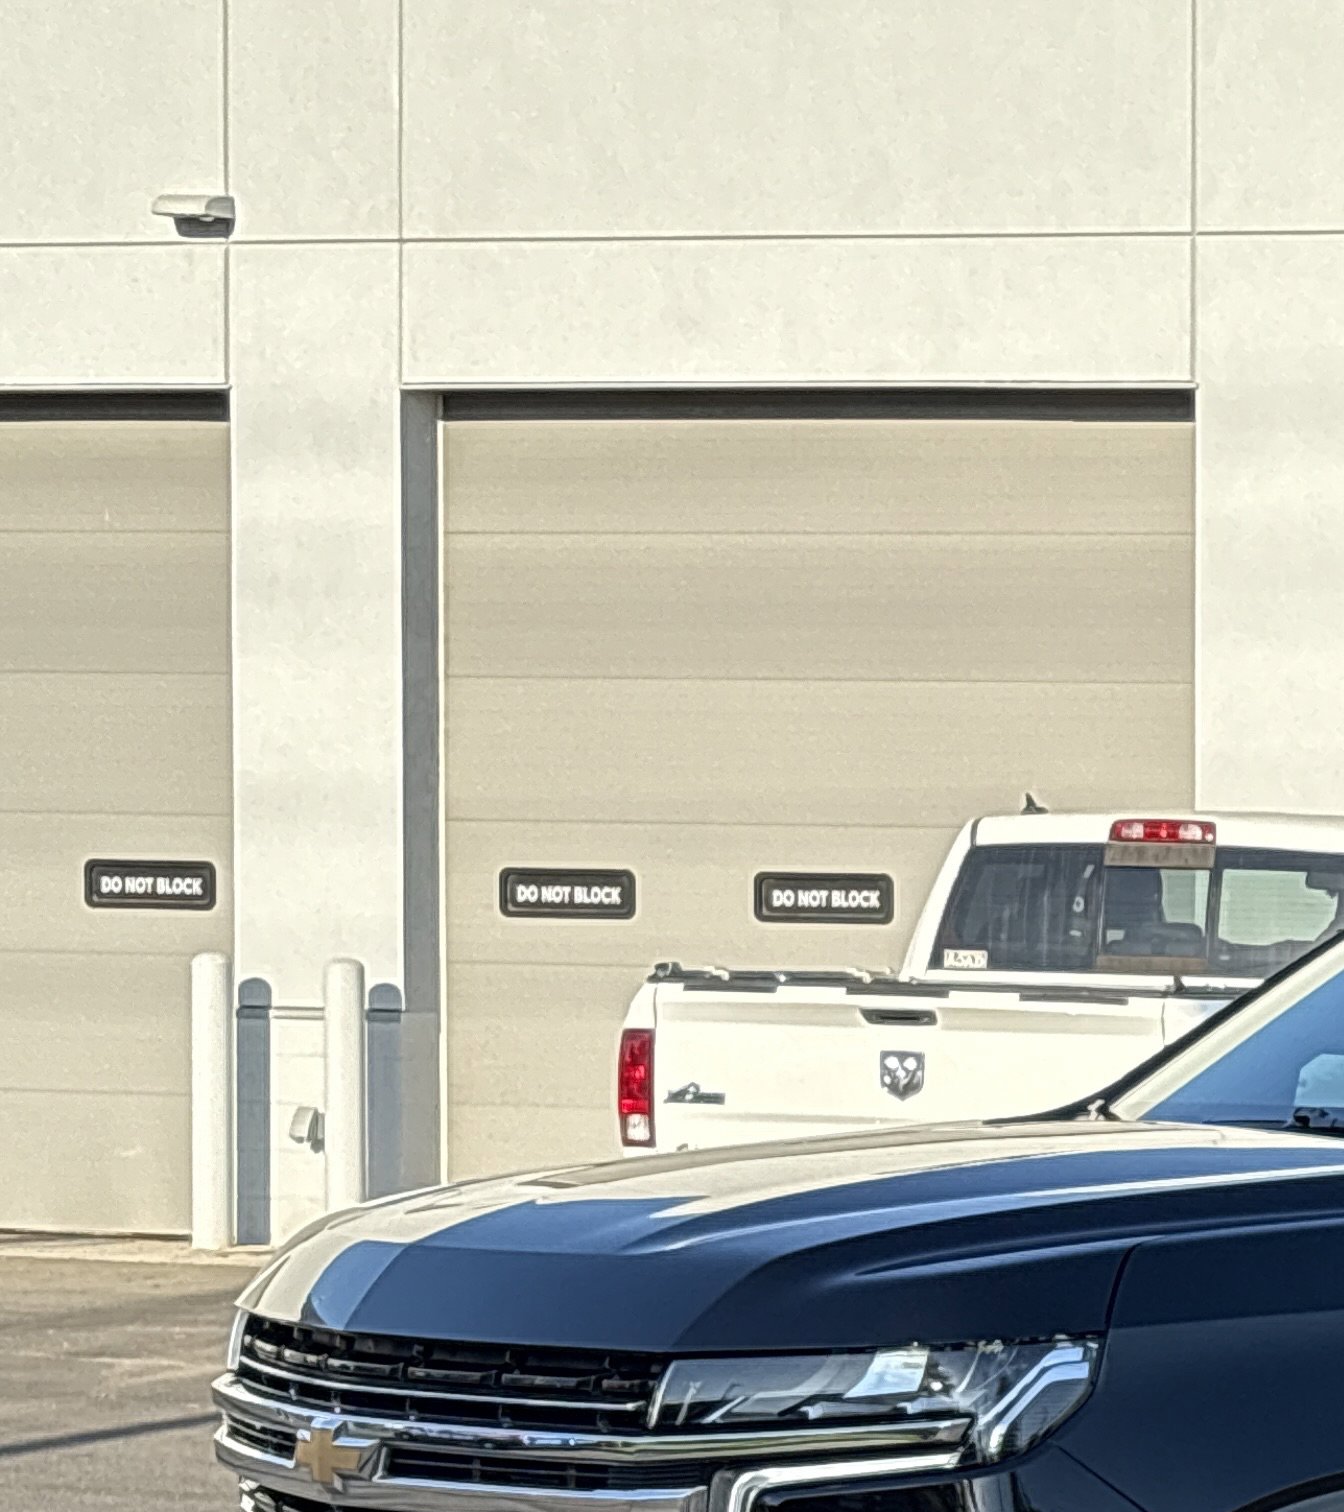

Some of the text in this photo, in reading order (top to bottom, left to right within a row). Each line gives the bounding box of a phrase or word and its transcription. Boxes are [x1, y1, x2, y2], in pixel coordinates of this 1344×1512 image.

[101, 875, 203, 896] DO NOT BLOCK
[516, 884, 622, 905] DO NOT BLOCK
[772, 889, 880, 909] DO NOT BLOCK
